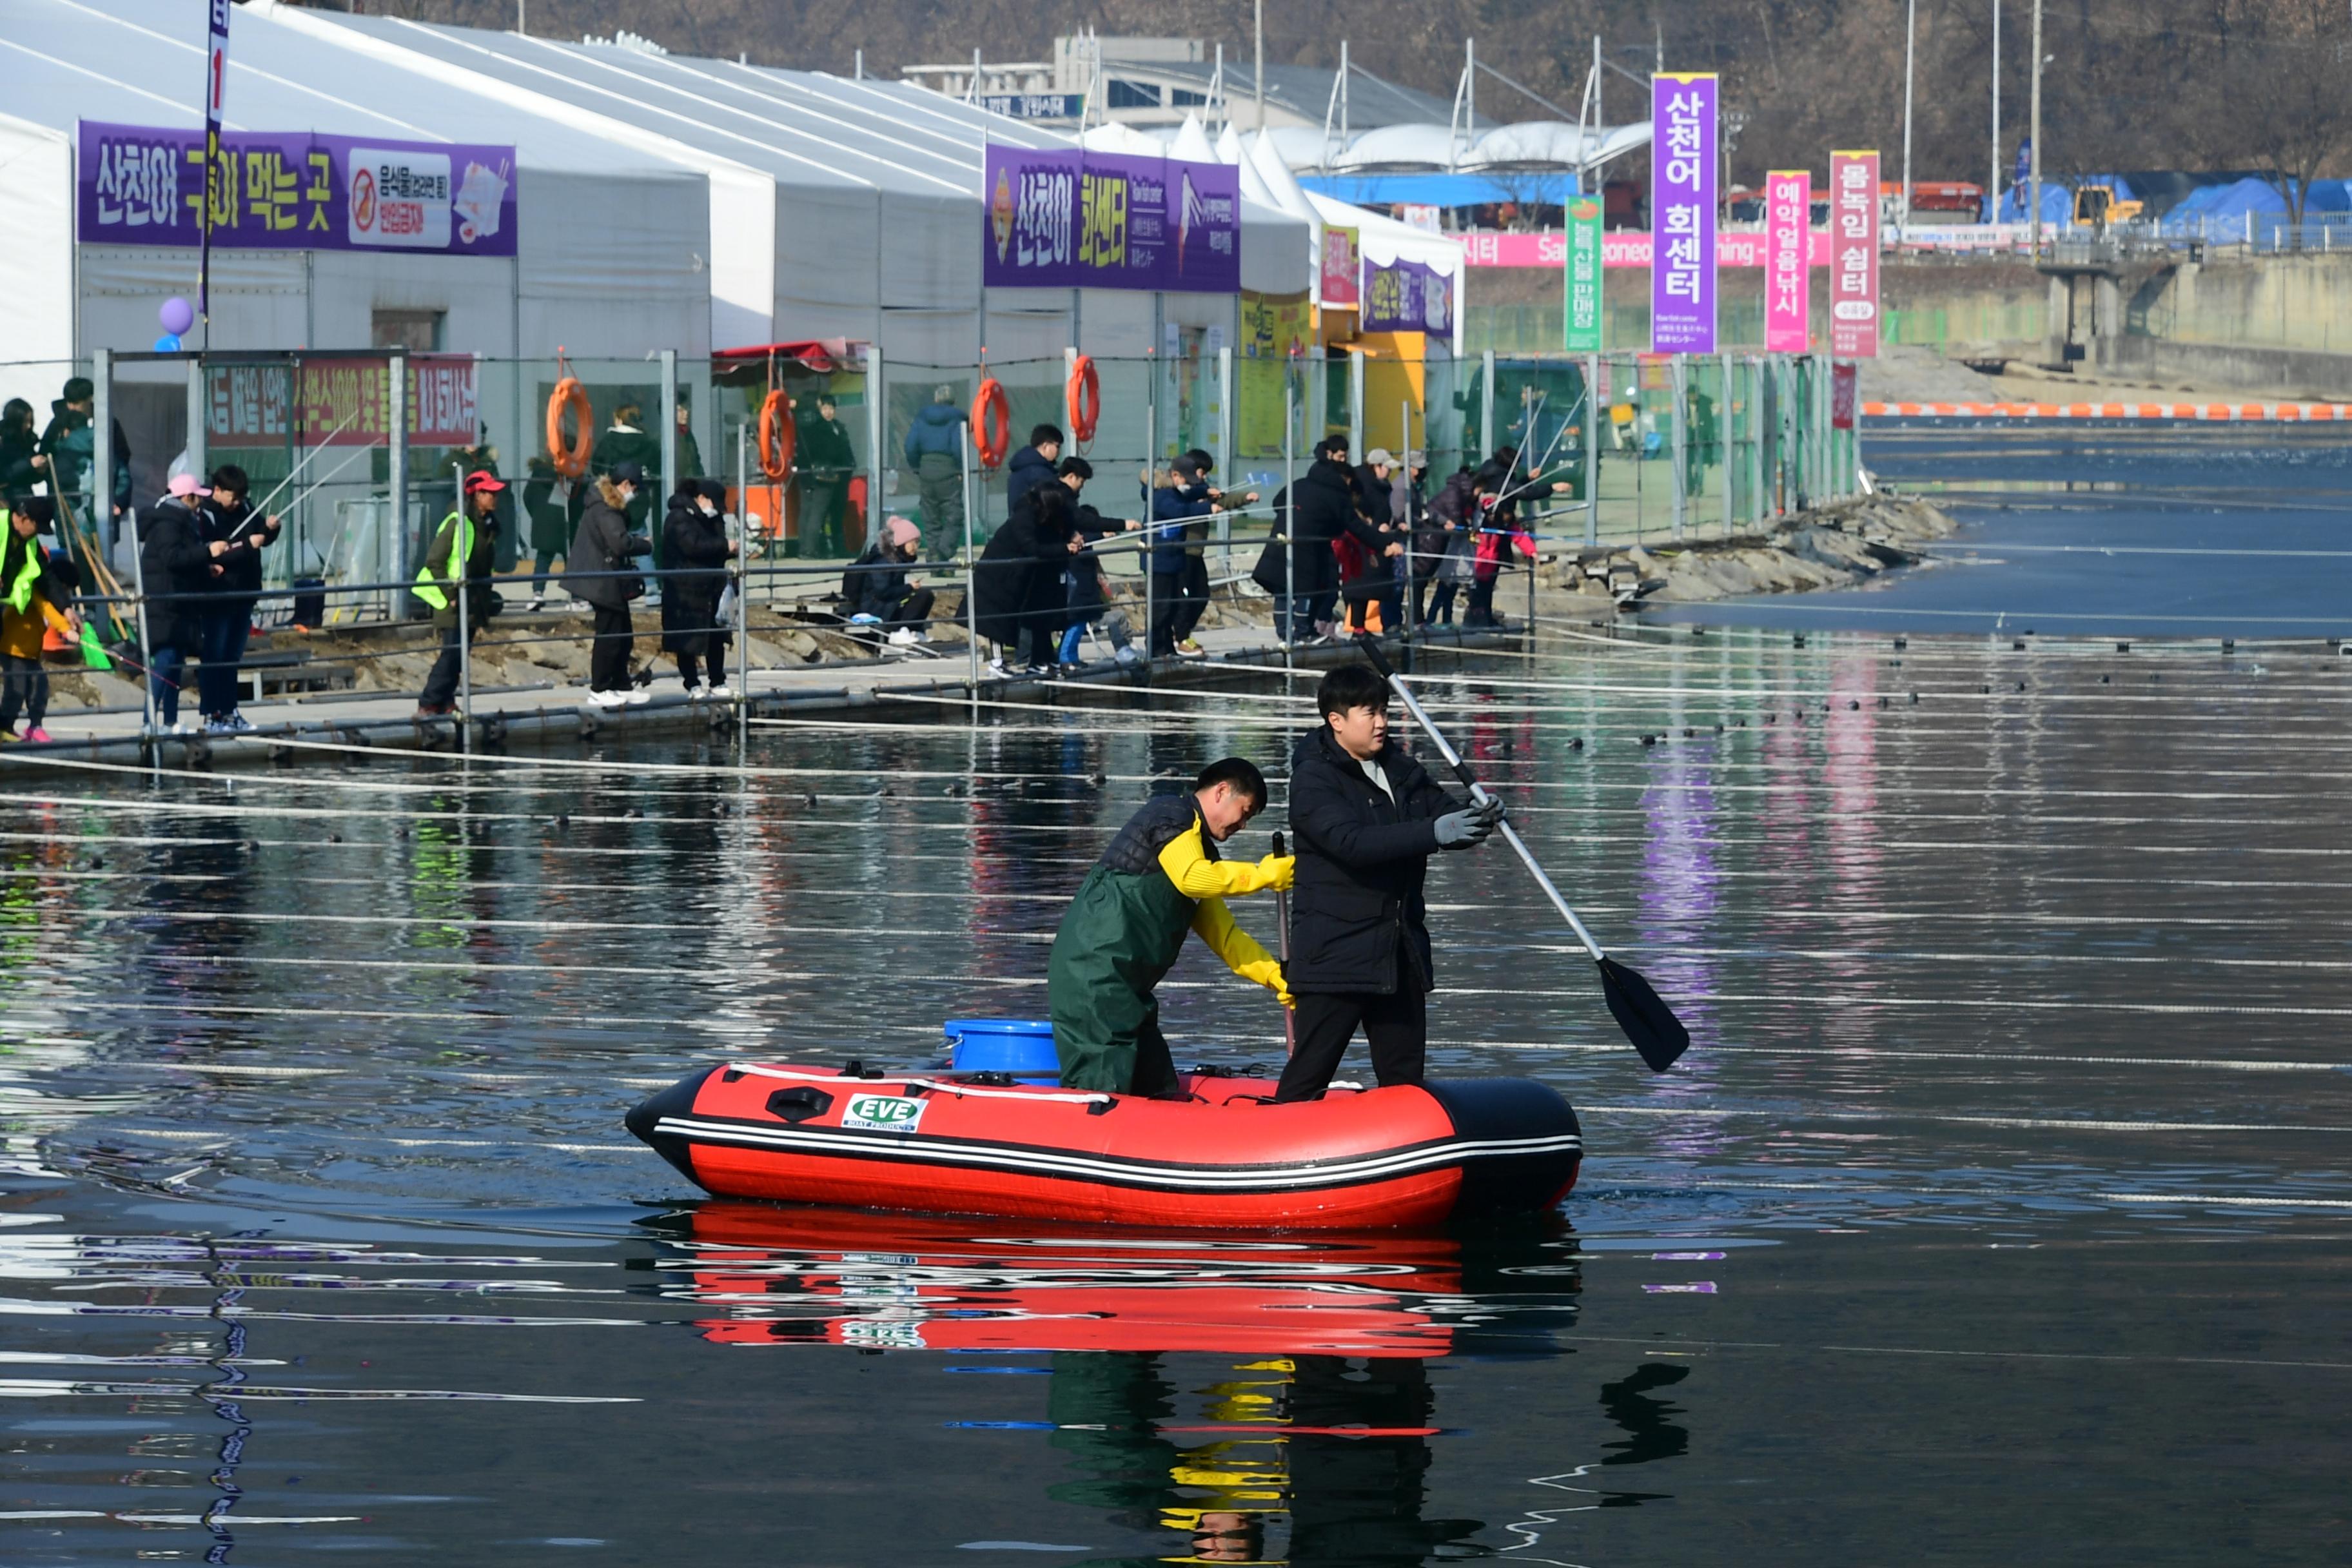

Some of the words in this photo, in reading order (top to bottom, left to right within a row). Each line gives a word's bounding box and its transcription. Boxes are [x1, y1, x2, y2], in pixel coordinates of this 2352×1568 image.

[1665, 92, 1705, 192] 산천어
[97, 144, 177, 226] 산천어
[246, 152, 298, 230] 먹는
[307, 153, 330, 230] 곳
[1016, 172, 1073, 266] 산천어
[1079, 173, 1126, 268] 회센터
[1839, 164, 1870, 239] 몸녹임
[1464, 234, 1498, 264] 시터
[1663, 203, 1701, 304] 회센터
[1776, 182, 1801, 317] 예약얼음낚시
[1839, 246, 1869, 296] 쉼터
[1573, 284, 1594, 328] 판매장
[859, 1099, 912, 1120] EVE
[870, 1121, 912, 1131] PRODUCTS
